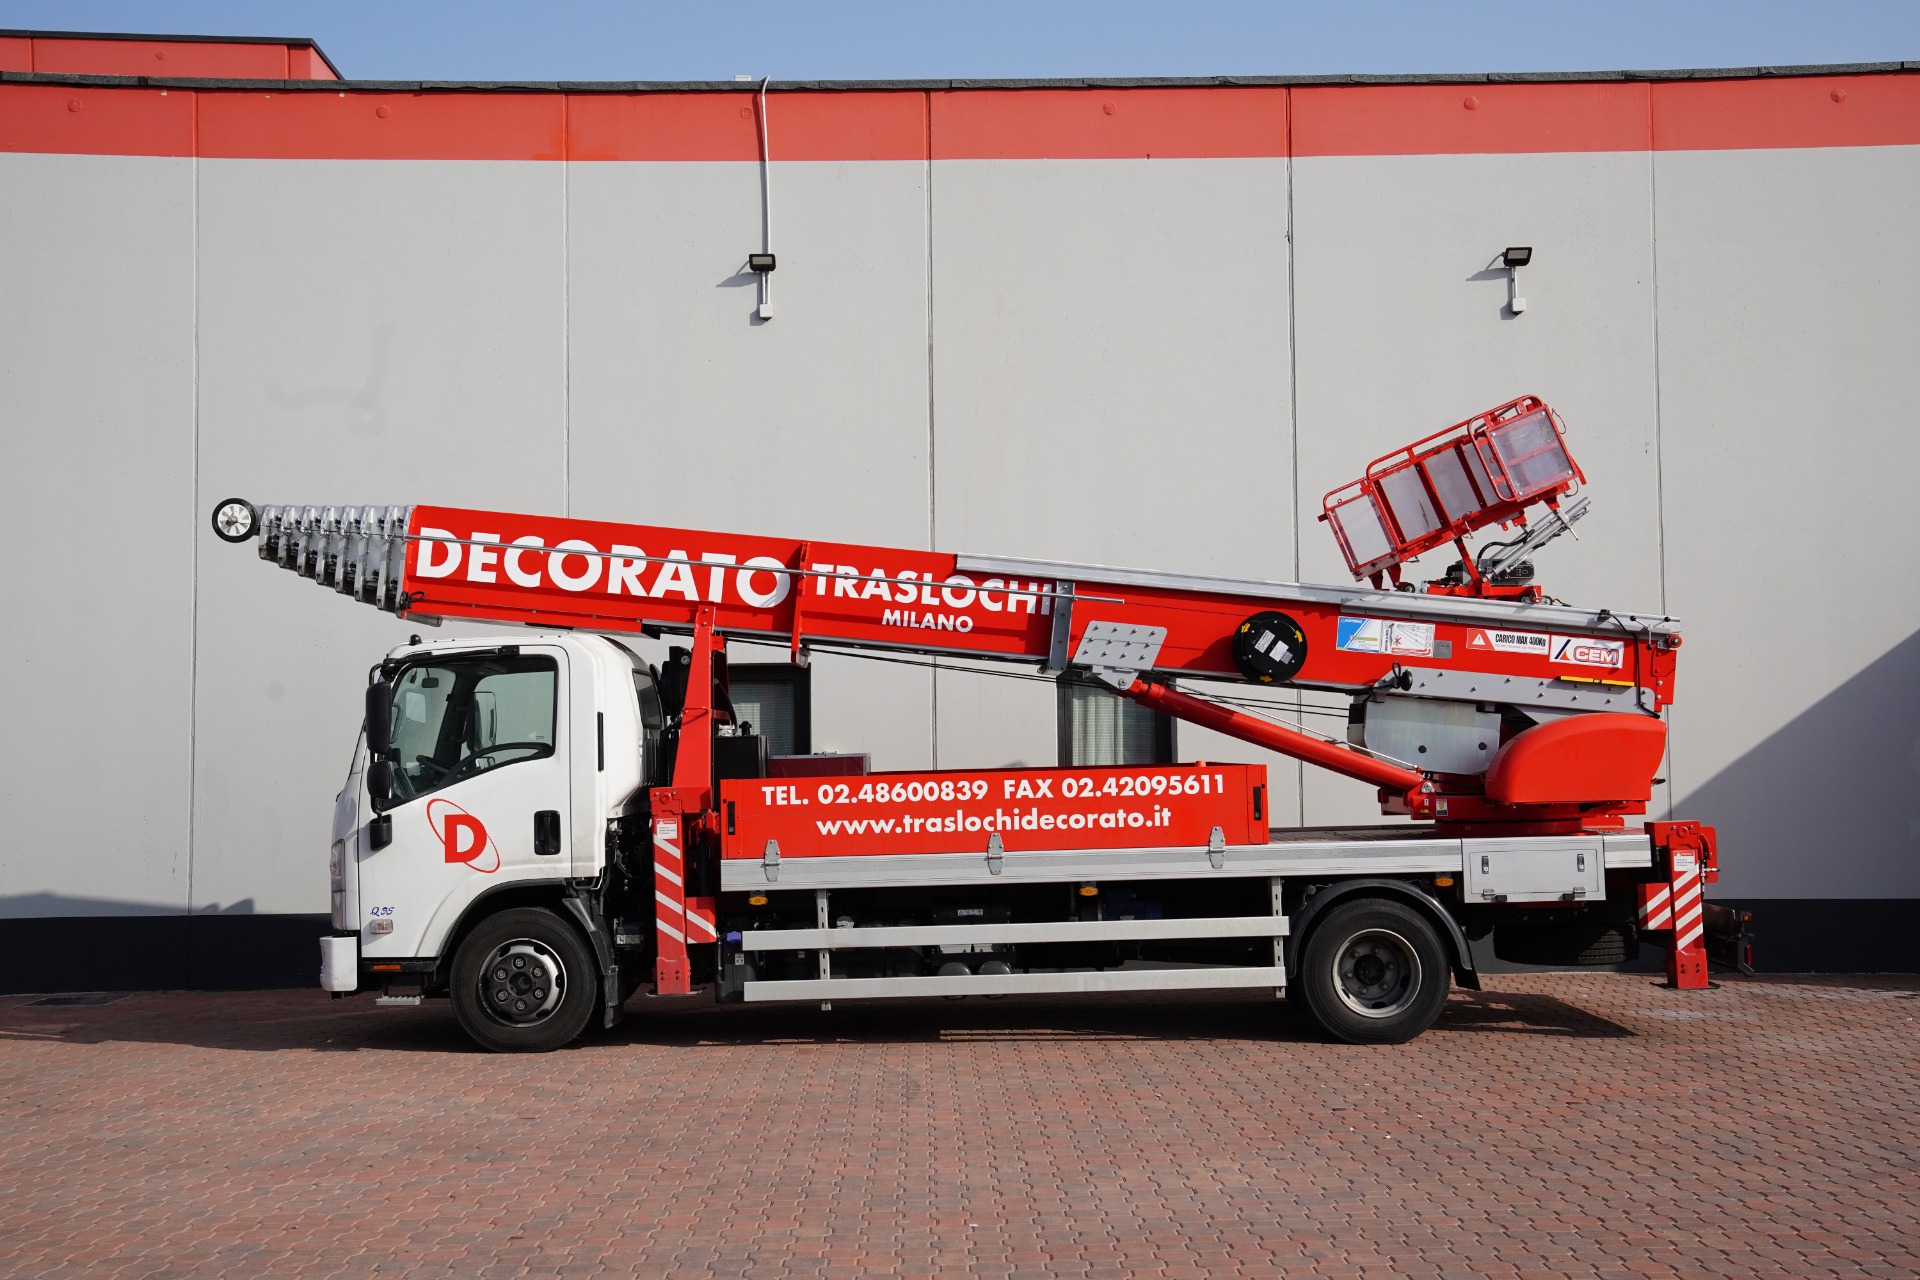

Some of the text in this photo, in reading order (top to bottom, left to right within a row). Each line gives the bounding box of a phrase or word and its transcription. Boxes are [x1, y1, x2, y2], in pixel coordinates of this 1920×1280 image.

[416, 527, 791, 608] DECORATO
[812, 563, 1053, 615] TRASLOCHI
[881, 608, 974, 633] MILANO
[1495, 633, 1515, 644] CARICO
[1516, 635, 1528, 645] MAX
[1574, 646, 1619, 665] CEM
[761, 774, 1224, 806] TEL. 02.48600839 FAX 02.42095611
[815, 804, 1172, 836] www.traslochidecorato.it
[444, 813, 488, 864] D
